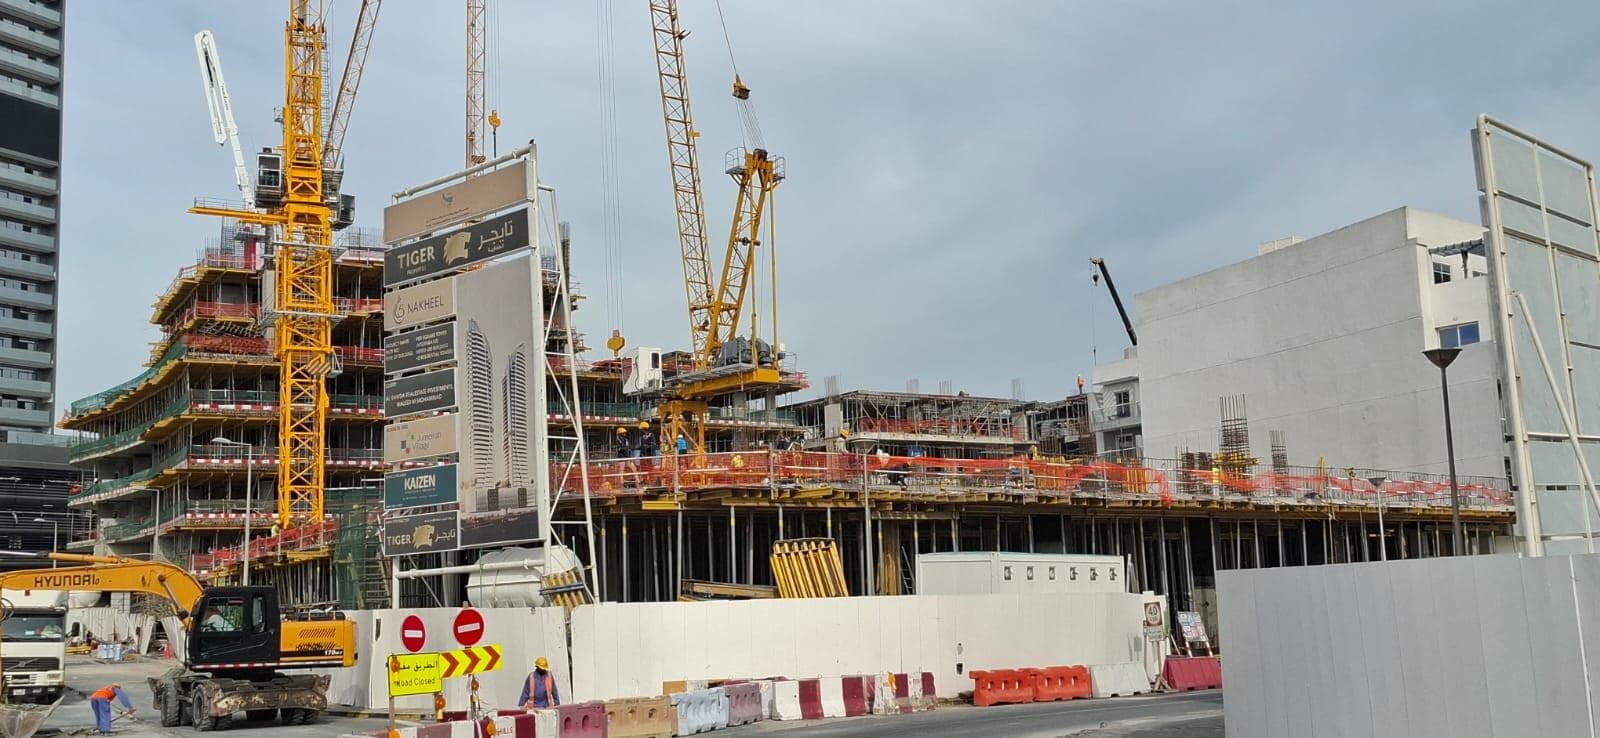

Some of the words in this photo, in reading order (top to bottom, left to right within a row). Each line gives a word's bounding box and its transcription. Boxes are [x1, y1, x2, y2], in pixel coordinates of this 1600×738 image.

[478, 220, 513, 250] تايجر
[397, 246, 436, 269] TIGER
[407, 295, 445, 314] NAKHEEL
[404, 474, 436, 491] KAIZEN
[386, 534, 411, 546] TIGER
[435, 528, 456, 543] تايجر
[34, 574, 95, 588] HYUNDAI
[1148, 605, 1158, 617] 40
[414, 677, 436, 686] Closed
